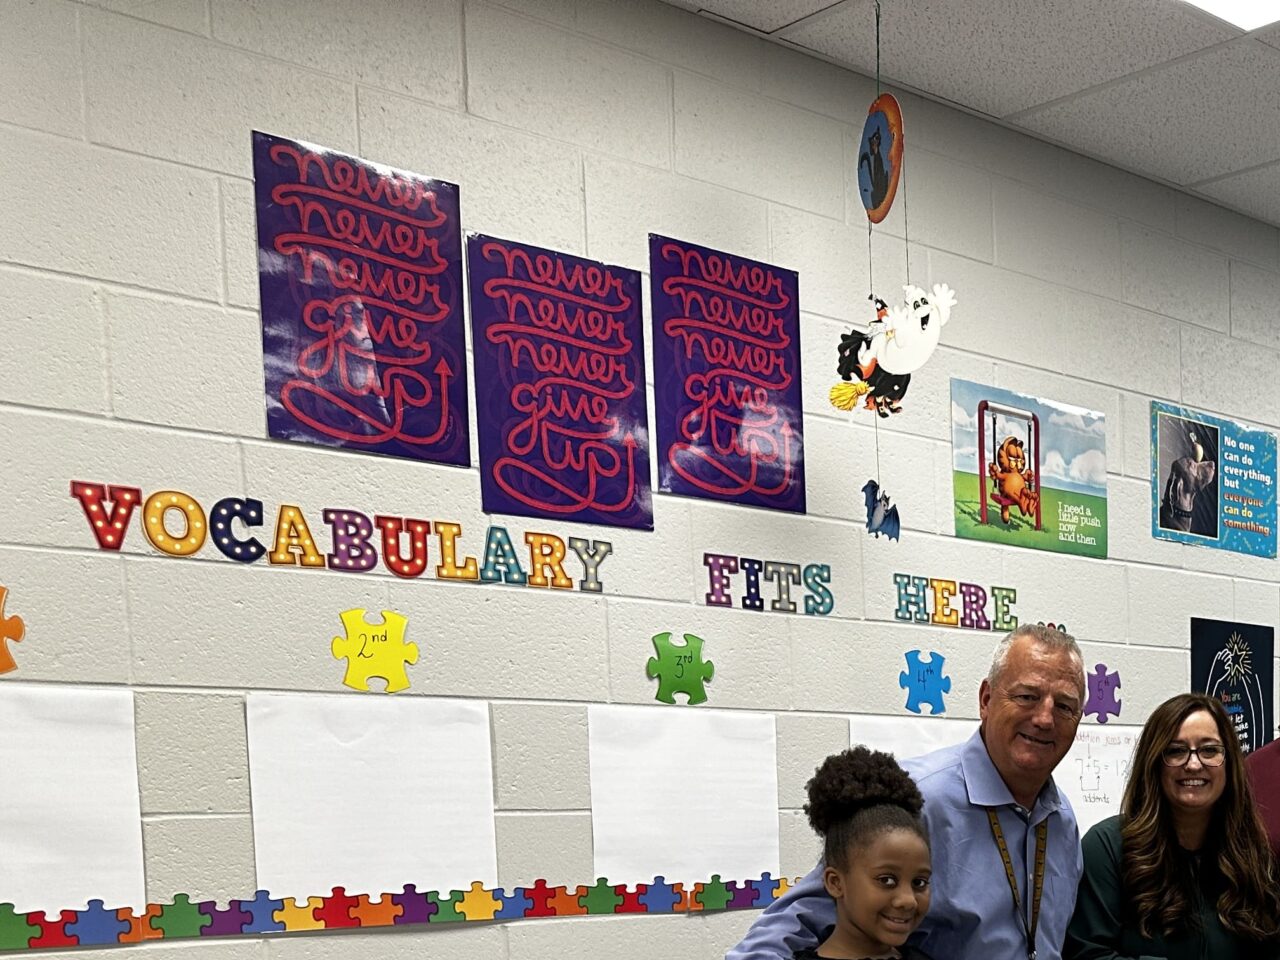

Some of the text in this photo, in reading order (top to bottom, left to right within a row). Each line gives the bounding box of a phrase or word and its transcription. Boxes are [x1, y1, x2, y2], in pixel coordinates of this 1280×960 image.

[271, 144, 446, 226] never
[273, 187, 447, 272] never
[482, 242, 632, 310] never
[662, 243, 789, 309] never
[485, 278, 632, 350] never
[664, 278, 790, 348] never
[299, 296, 430, 378] give
[508, 378, 618, 453] give
[682, 368, 777, 440] give
[1224, 436, 1255, 452] No one
[1224, 452, 1253, 465] can do
[1224, 465, 1273, 486] everything,
[1224, 477, 1240, 489] but
[1058, 501, 1092, 516] I need a
[1224, 492, 1264, 508] everyone
[1224, 504, 1253, 518] can do
[1059, 511, 1101, 527] little push
[1059, 522, 1076, 532] now
[69, 480, 612, 593] VOCABULARY
[703, 552, 834, 616] FITS
[1058, 532, 1096, 545] and then
[357, 630, 388, 659] 2nd
[674, 653, 693, 679] 3rd
[917, 666, 935, 691] 4th
